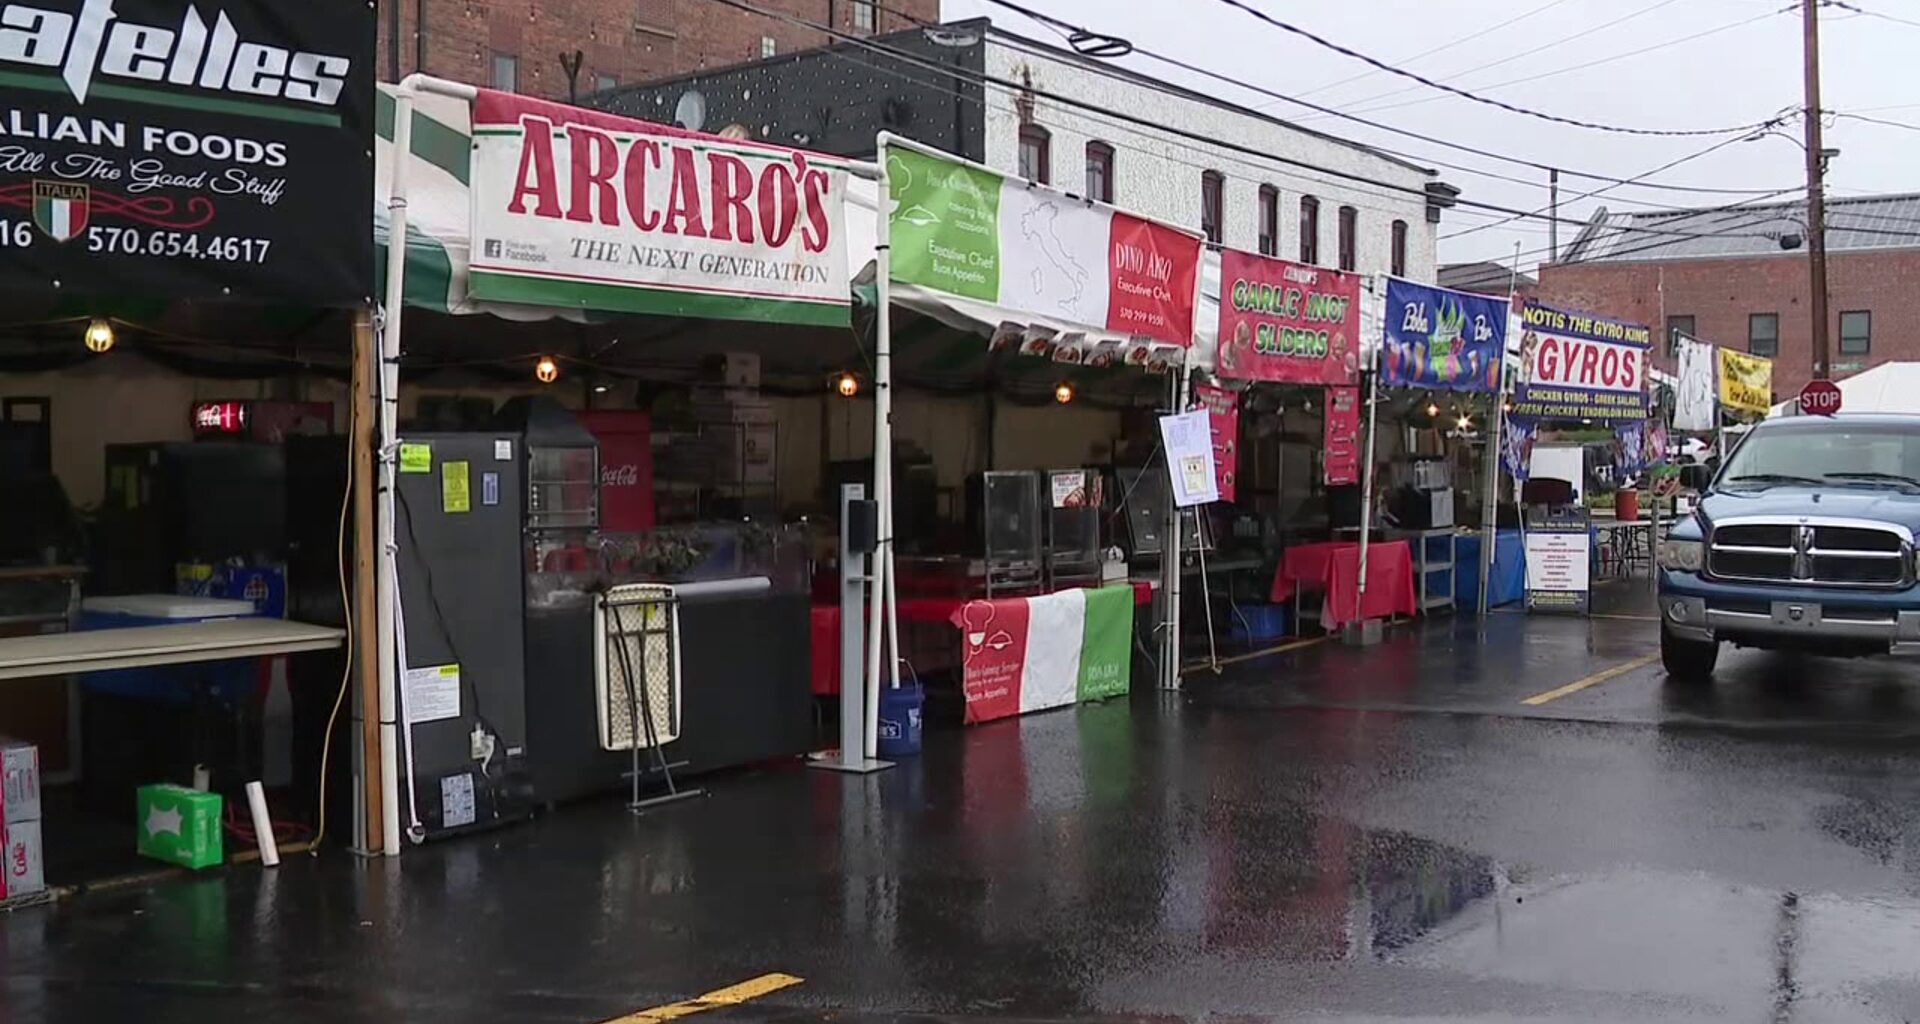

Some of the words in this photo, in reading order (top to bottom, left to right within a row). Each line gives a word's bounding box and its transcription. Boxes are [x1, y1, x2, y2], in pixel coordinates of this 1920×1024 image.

[143, 126, 287, 167] FOODS
[38, 183, 85, 199] ITALIA
[51, 153, 121, 180] The
[127, 158, 206, 193] Good
[210, 168, 286, 204] Stuff
[507, 116, 829, 253] ARCARO'S
[88, 226, 271, 263] 570.654.4617
[570, 237, 621, 262] THE
[627, 244, 695, 271] NEXT
[700, 253, 830, 284] GENERATION
[968, 251, 994, 270] Chef
[1115, 241, 1144, 274] DINO
[1117, 276, 1152, 298] Executive
[1231, 277, 1302, 319] GARLIC
[1253, 322, 1329, 358] SLIDERS
[1523, 306, 1566, 330] NOTIS
[1568, 315, 1593, 334] THE
[1593, 320, 1624, 340] GYRO
[1625, 327, 1650, 344] KING
[1537, 337, 1636, 388] GYROS
[1513, 403, 1543, 414] FRESH
[1543, 404, 1579, 416] CHICKEN
[1527, 388, 1562, 401] CHICKEN
[1564, 390, 1589, 404] GYROS
[1802, 391, 1840, 408] STOP
